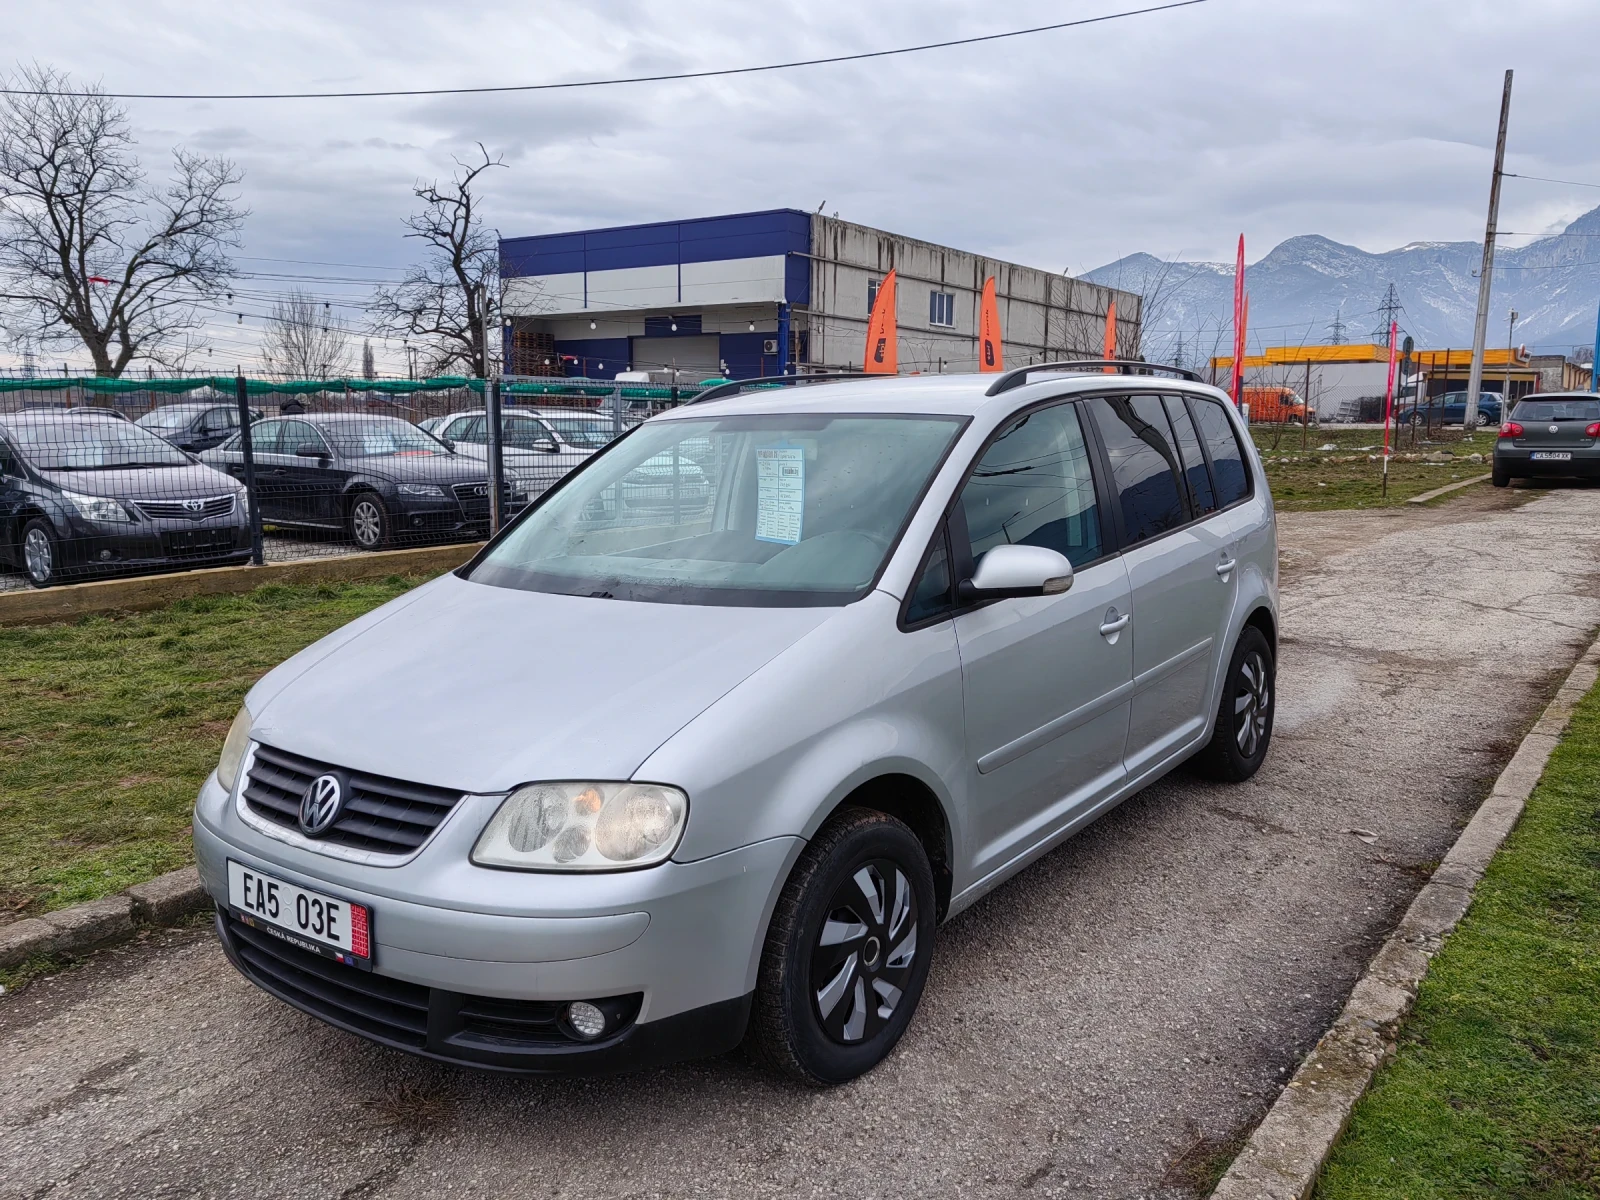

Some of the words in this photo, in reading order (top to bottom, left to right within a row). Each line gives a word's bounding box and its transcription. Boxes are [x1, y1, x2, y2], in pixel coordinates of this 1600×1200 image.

[243, 872, 279, 919] EA5
[296, 893, 340, 942] 03E
[266, 926, 286, 940] ČESKÁ
[286, 935, 321, 953] REPUBLIKA
